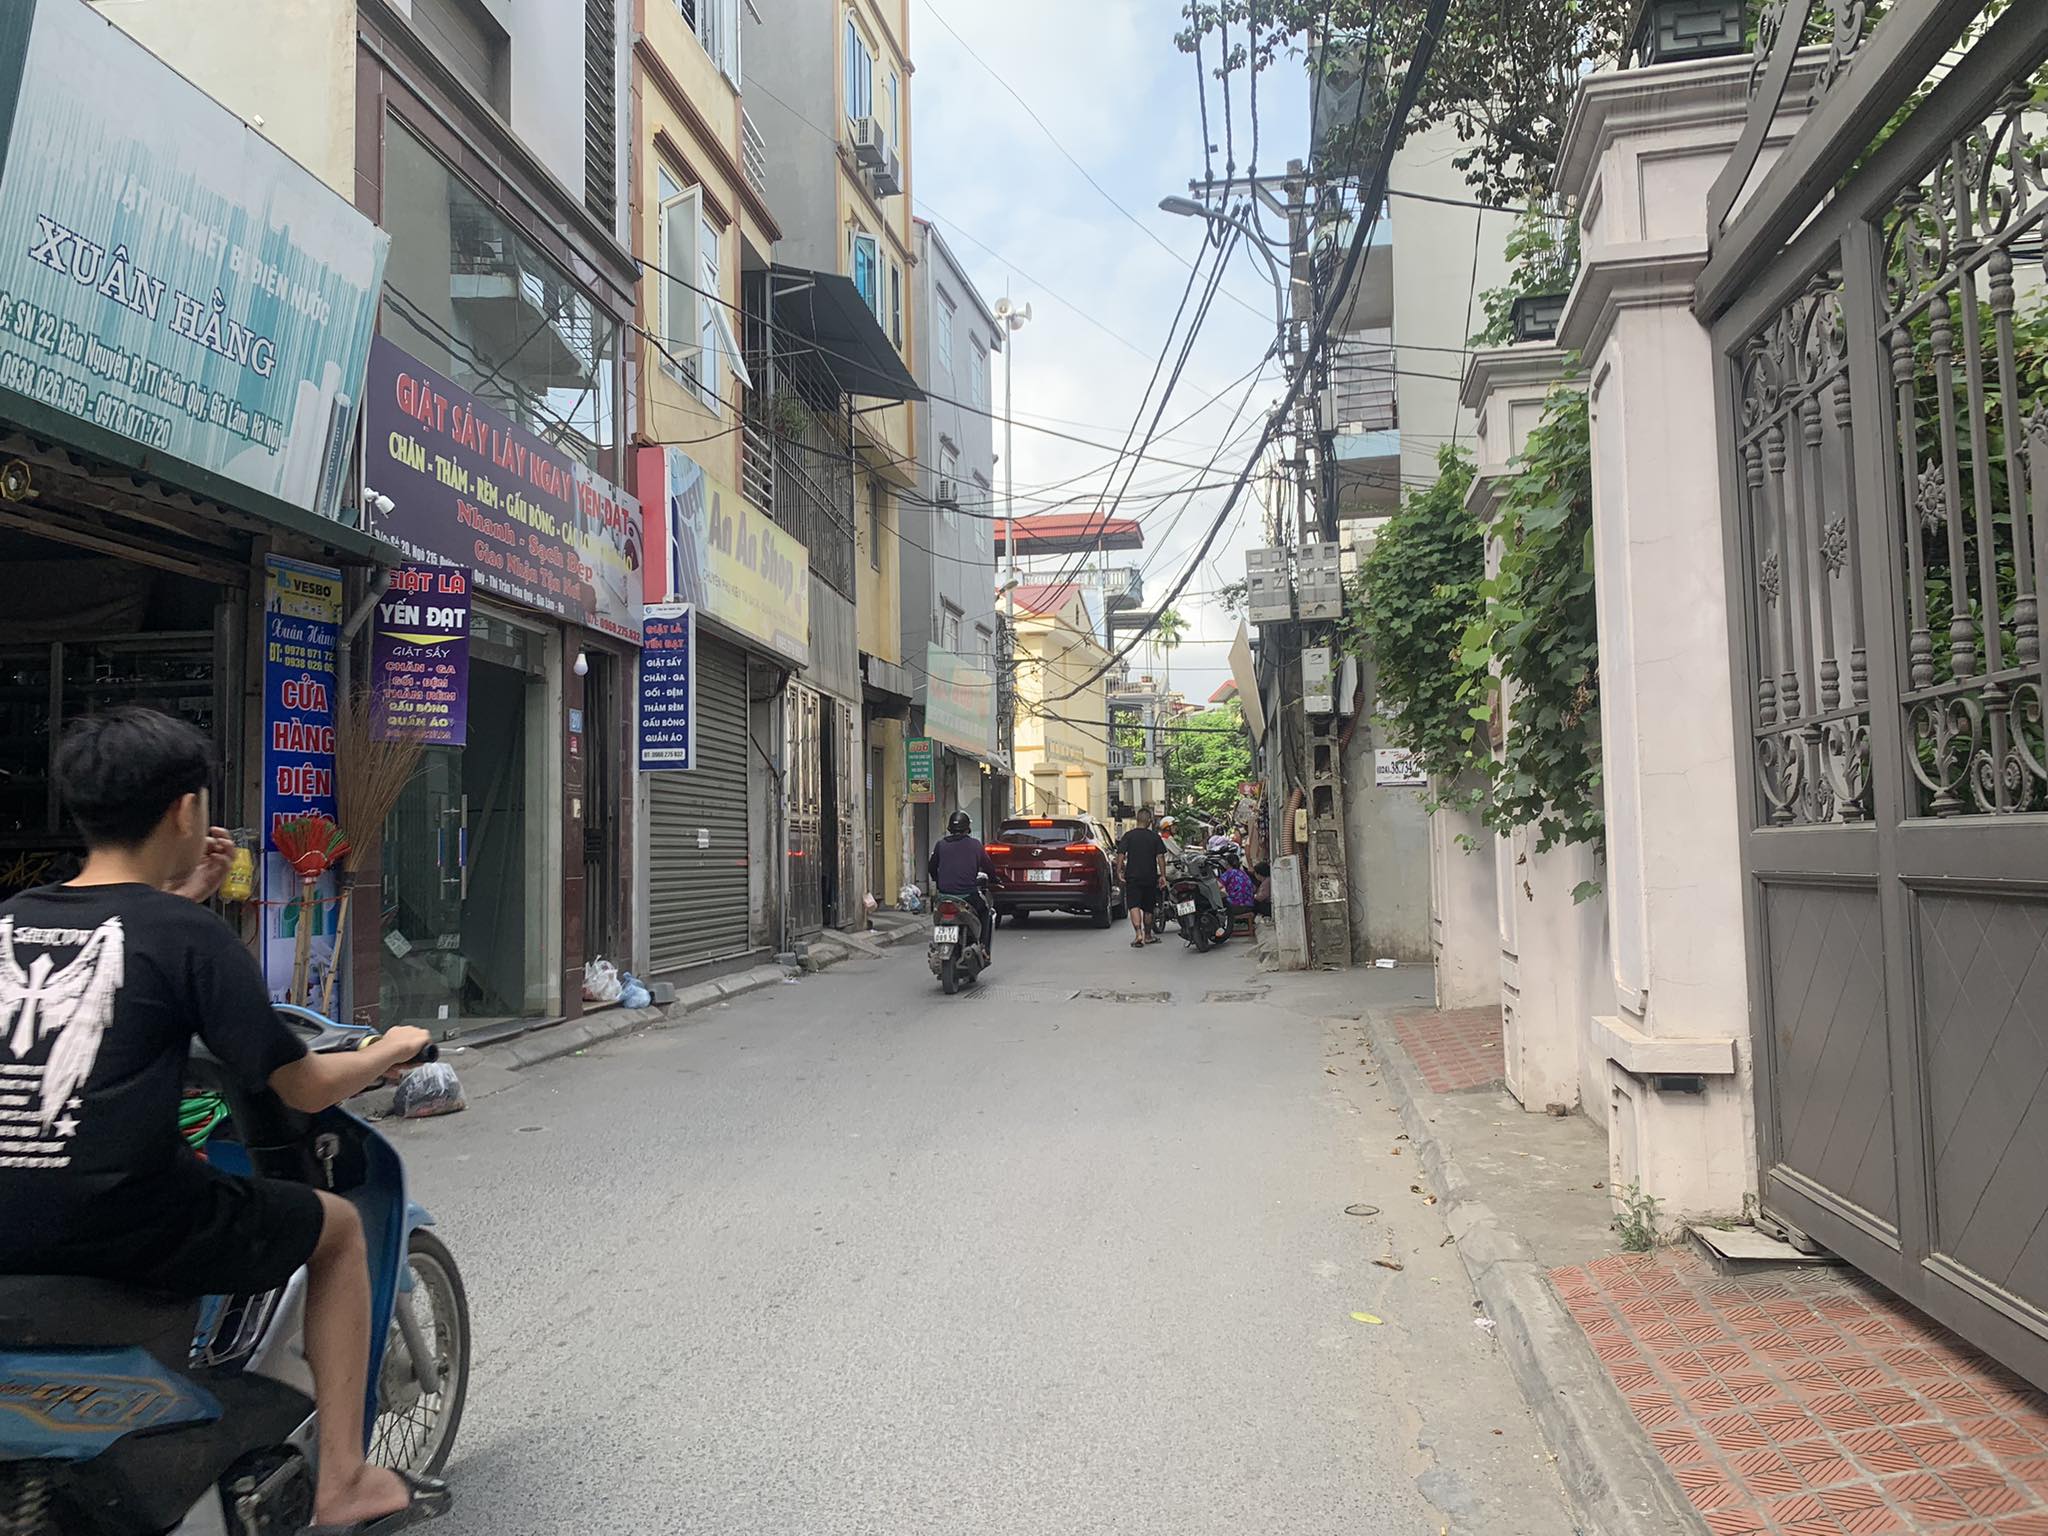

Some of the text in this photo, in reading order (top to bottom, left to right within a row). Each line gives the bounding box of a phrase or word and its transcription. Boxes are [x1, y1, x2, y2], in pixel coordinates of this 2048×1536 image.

[28, 213, 277, 379] XUÂN HẰNG
[250, 258, 289, 303] ĐIỆN
[290, 282, 331, 327] NƯỚC
[0, 350, 88, 419] 0938.026.059
[14, 300, 37, 340] SN
[36, 312, 57, 354] 22,
[57, 319, 85, 364] Đào
[85, 330, 131, 386] Nguyên
[144, 361, 162, 397] TT
[157, 367, 188, 411] Châu
[207, 390, 229, 427] Gia
[227, 399, 250, 441] Lâm,
[250, 410, 266, 444] Hà
[262, 414, 284, 456] Nội
[395, 372, 629, 538] GIẶT SẤY LẤY NGAY YẾN ĐẠT
[388, 431, 427, 474] CHĂN
[434, 455, 469, 496] THẢM
[476, 473, 500, 511] RÈM
[506, 490, 528, 527] GẤU
[527, 508, 557, 540] BÔNG
[456, 498, 517, 548] Nhanh
[527, 534, 565, 569] Sạch
[708, 489, 734, 557] An
[735, 509, 758, 574] An
[759, 526, 794, 600] Shop
[389, 566, 433, 596] GIẶT
[474, 539, 504, 570] Giao
[505, 552, 540, 586] Nhận
[539, 565, 562, 596] Tận
[293, 578, 332, 597] VESBO
[271, 617, 304, 642] Xuân
[380, 598, 467, 632] YẾN ĐẠT
[284, 644, 306, 657] 0978
[392, 645, 451, 659] GIẶT SẤY
[646, 656, 683, 669] GIẶT SẤY
[385, 661, 426, 674] CHĂN
[435, 663, 457, 674] GA
[643, 671, 667, 682] CHĂN
[672, 673, 686, 682] GA
[282, 672, 329, 713] CỬA
[388, 699, 449, 714] GẤU BÔNG
[644, 687, 661, 698] GỐI
[666, 687, 684, 698] ĐỆM
[668, 701, 685, 712] RÈM
[272, 716, 336, 755] HÀNG
[642, 716, 686, 728] GẤU BÔNG
[669, 731, 683, 742] ÁO
[276, 761, 333, 803] ĐIỆN
